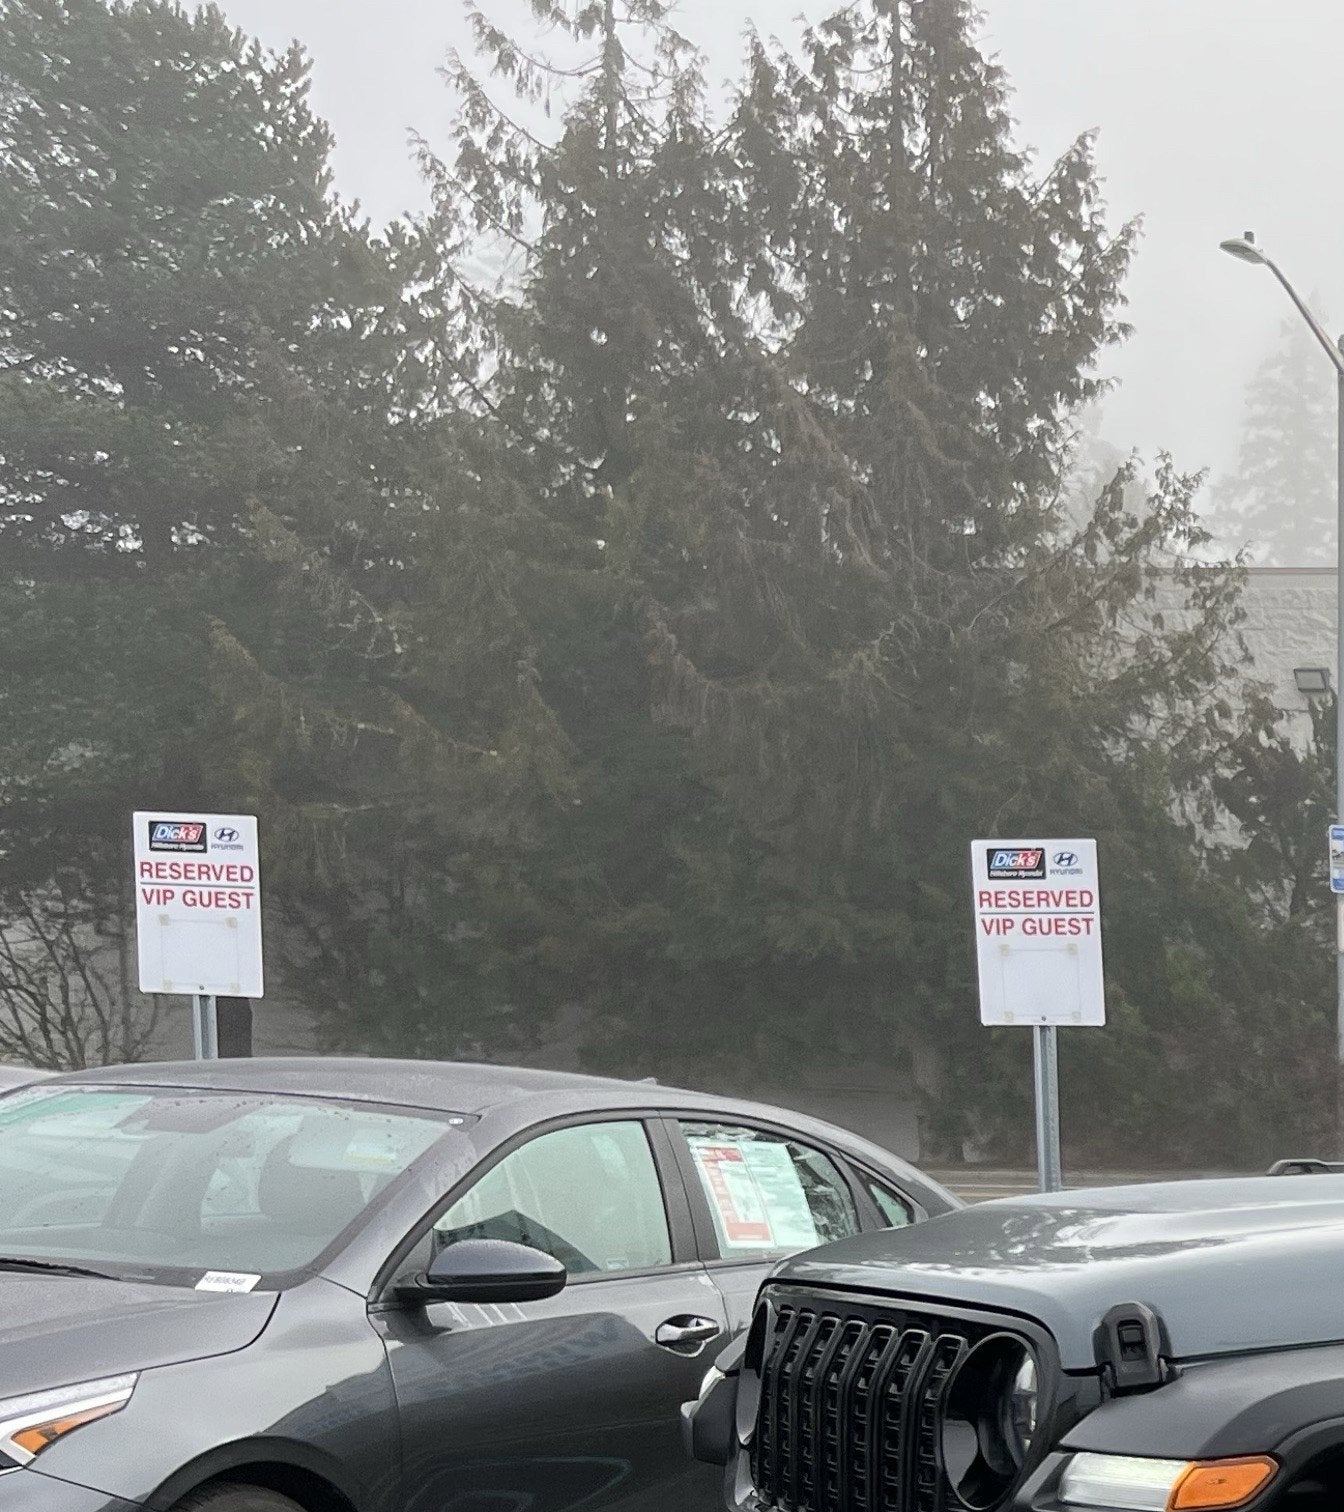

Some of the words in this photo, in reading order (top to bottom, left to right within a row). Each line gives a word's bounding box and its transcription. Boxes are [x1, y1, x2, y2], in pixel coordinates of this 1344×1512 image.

[995, 853, 1037, 867] Dick's
[140, 861, 254, 882] RESERVED
[142, 888, 175, 906] VIP
[182, 890, 254, 909] GUEST
[979, 890, 1094, 909] RESERVED
[981, 918, 1015, 936] VIP
[1022, 917, 1094, 936] GUEST
